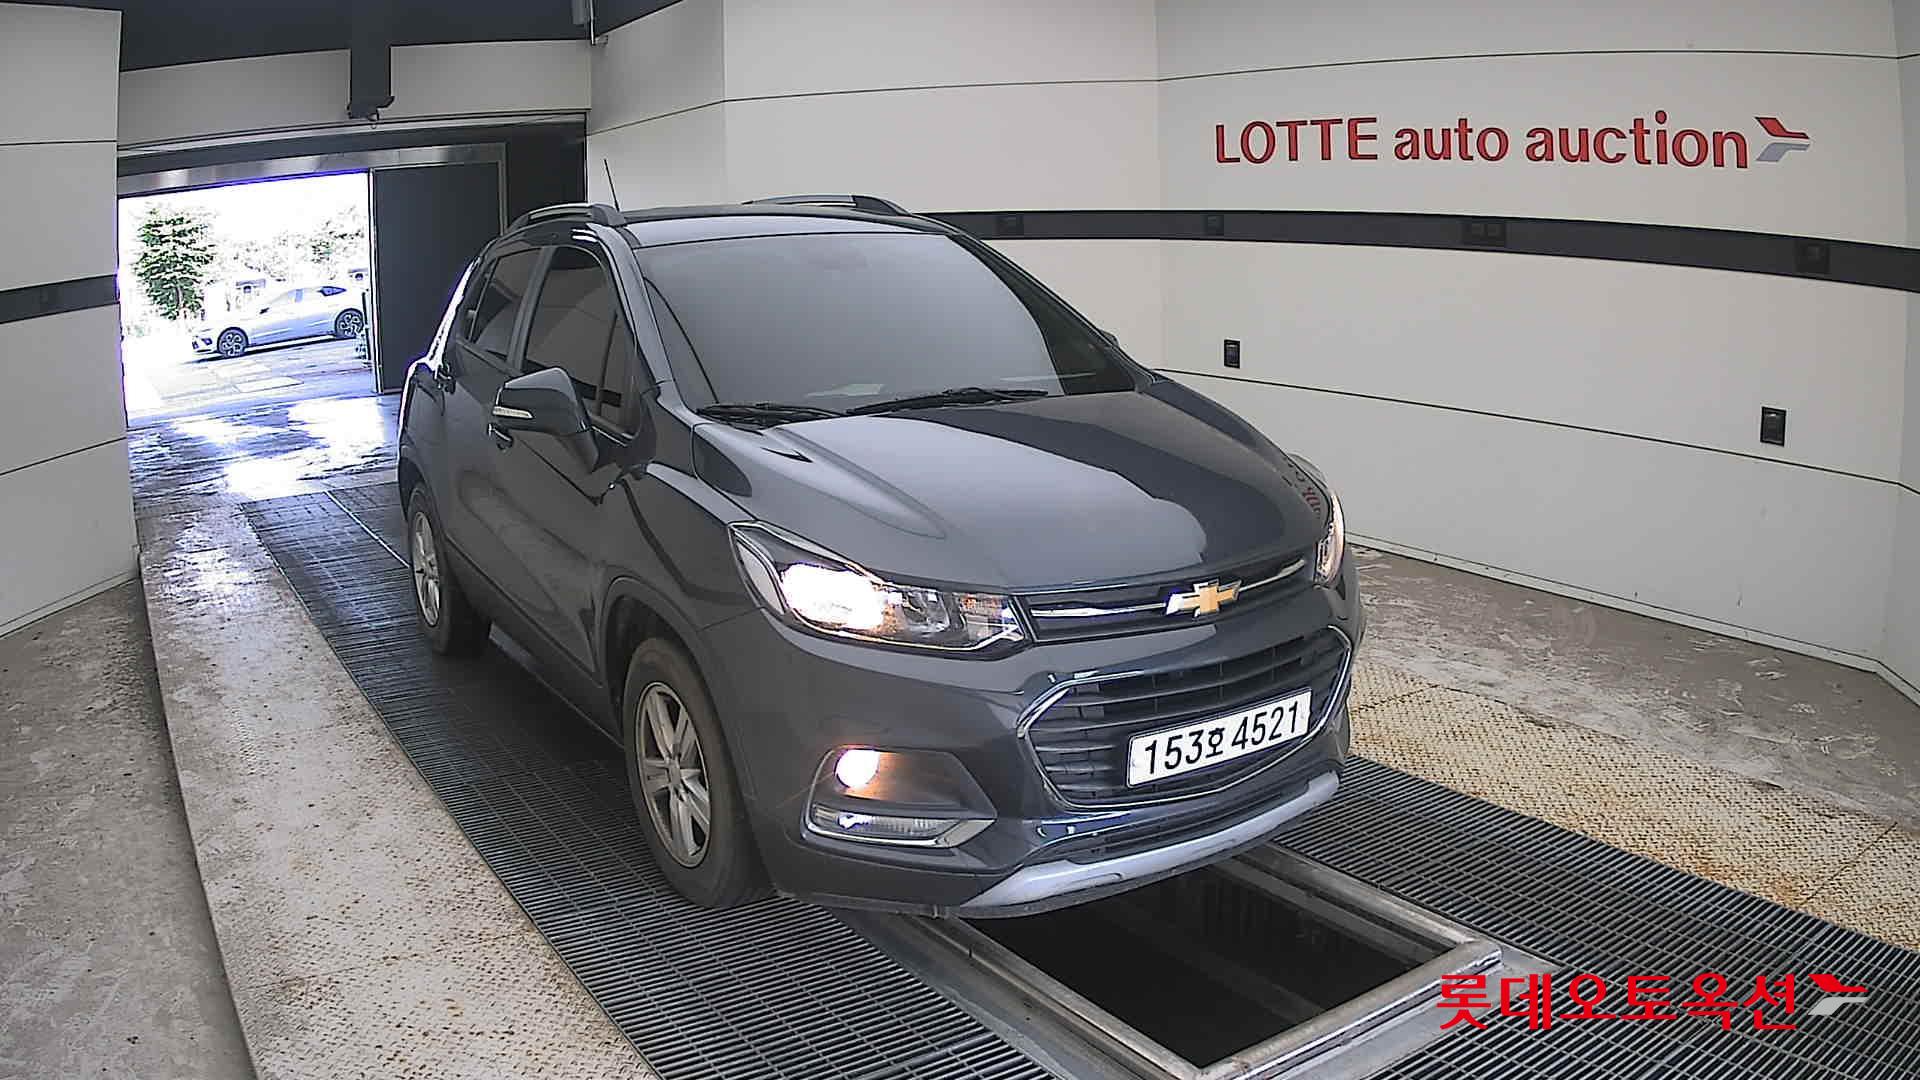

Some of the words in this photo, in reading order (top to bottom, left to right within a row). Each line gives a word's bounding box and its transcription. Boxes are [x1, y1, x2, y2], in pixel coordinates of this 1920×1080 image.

[1216, 117, 1376, 163] LOTTE
[1395, 118, 1511, 161] auto
[1524, 110, 1749, 168] auction
[1144, 727, 1226, 775] 153호
[1231, 700, 1299, 751] 4521
